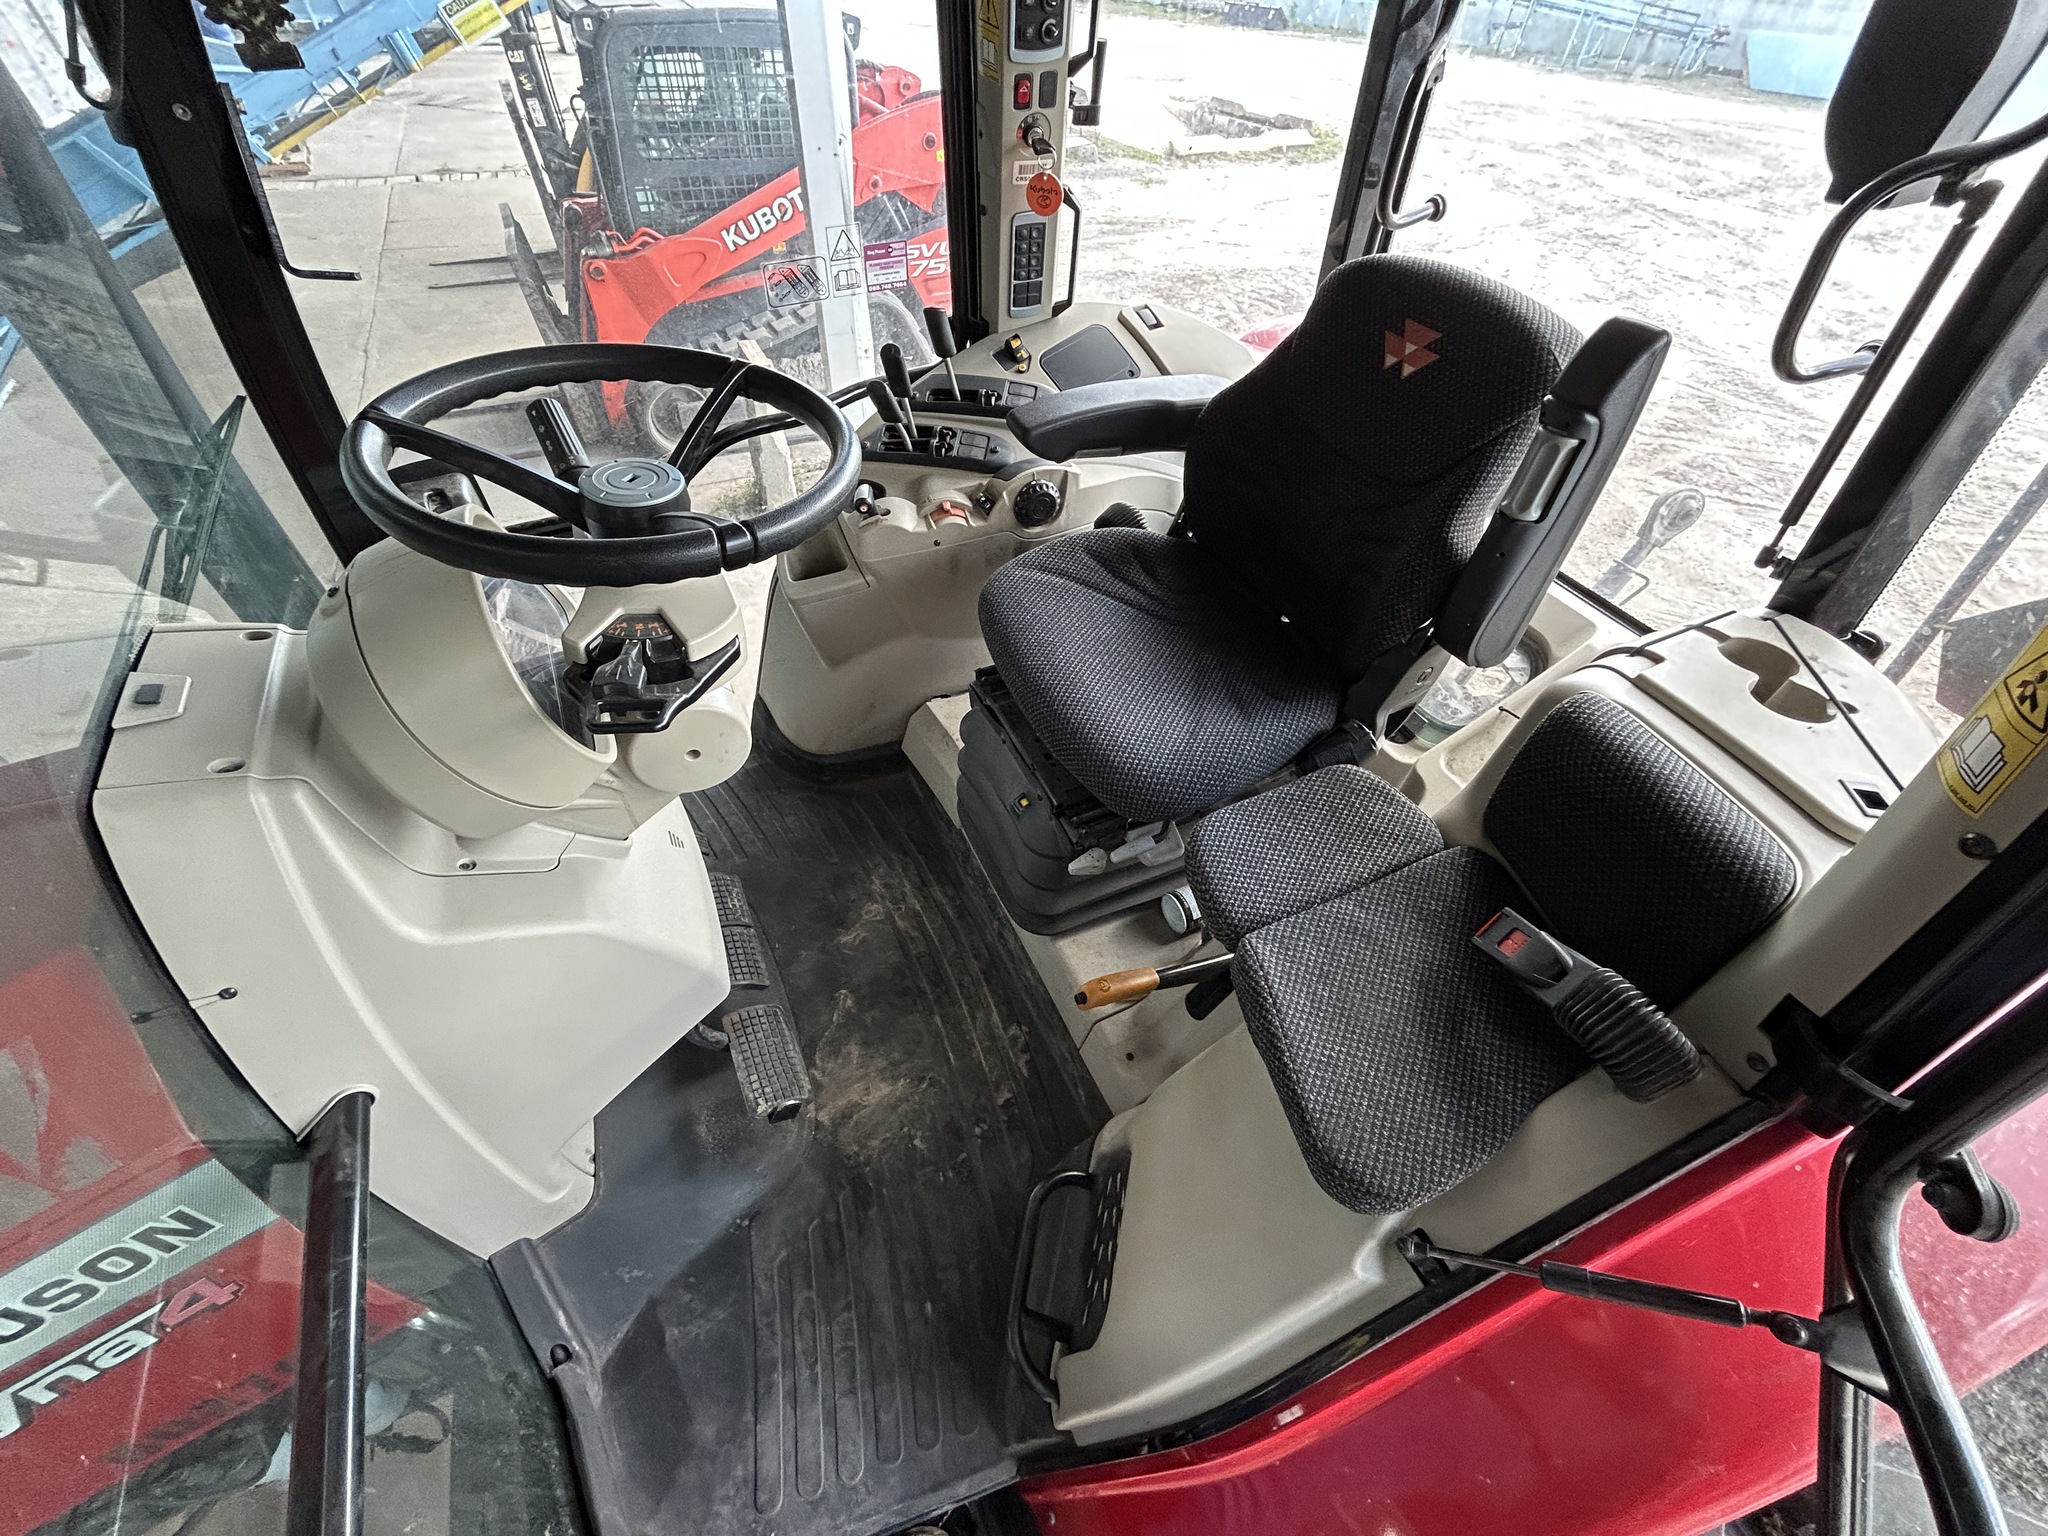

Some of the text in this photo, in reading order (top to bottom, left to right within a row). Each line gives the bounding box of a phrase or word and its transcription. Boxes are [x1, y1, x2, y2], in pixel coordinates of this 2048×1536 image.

[508, 50, 525, 62] CAT
[1030, 184, 1058, 196] Kubota
[721, 186, 804, 252] KUBOT
